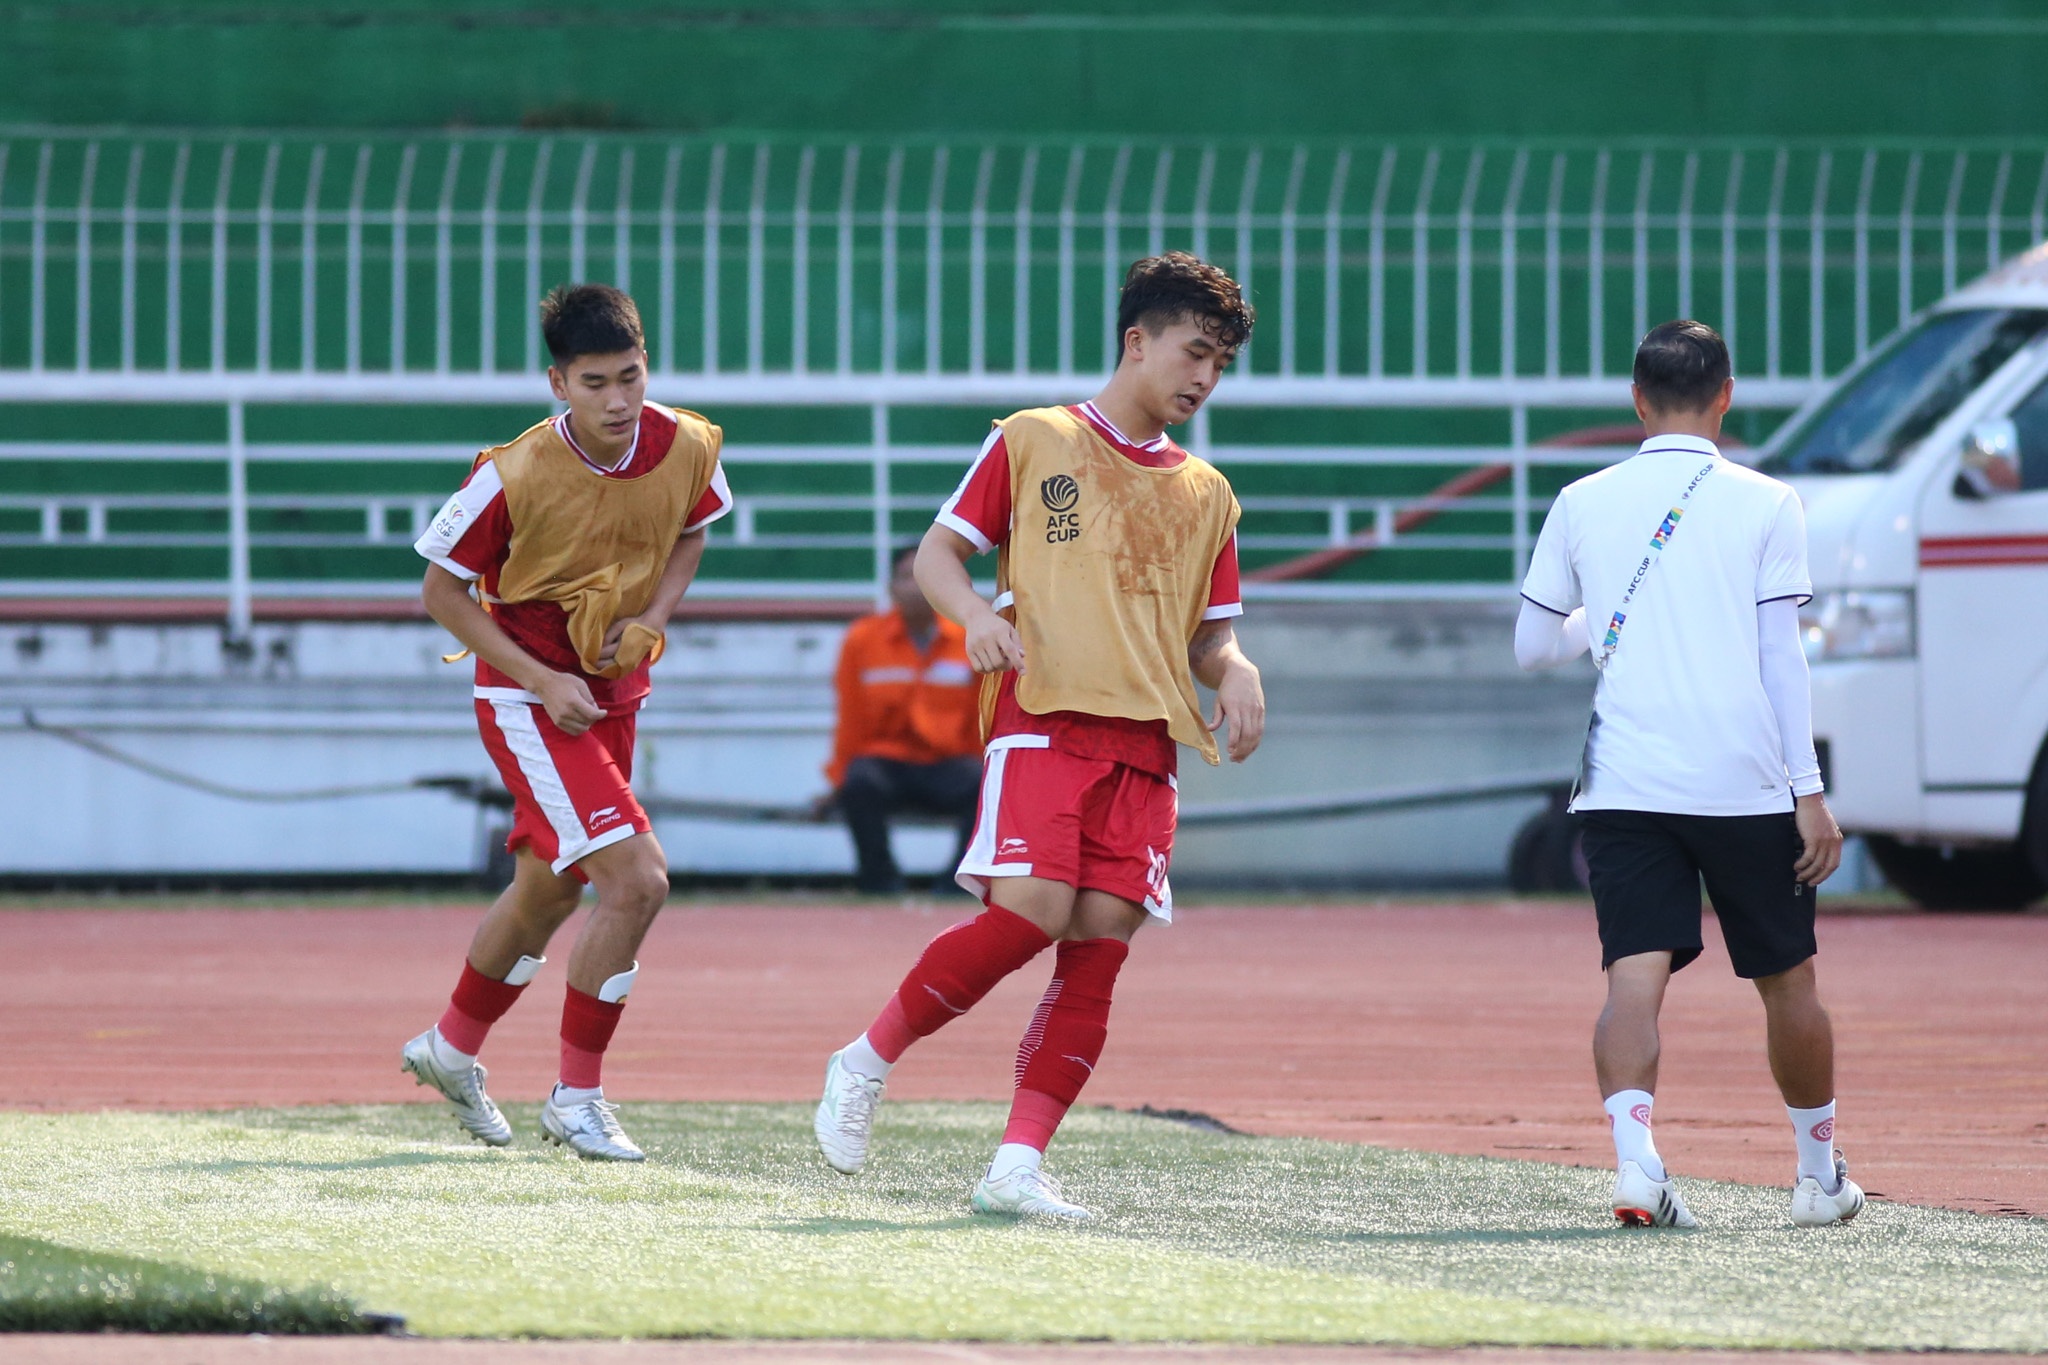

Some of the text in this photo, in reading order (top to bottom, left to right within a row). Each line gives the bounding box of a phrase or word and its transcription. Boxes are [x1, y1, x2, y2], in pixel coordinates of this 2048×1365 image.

[1688, 475, 1703, 492] AFC
[441, 518, 455, 533] AFC
[1046, 513, 1080, 530] AFC
[436, 523, 451, 538] CUP
[1046, 528, 1080, 544] CUP
[1627, 557, 1650, 596] AFC CUP
